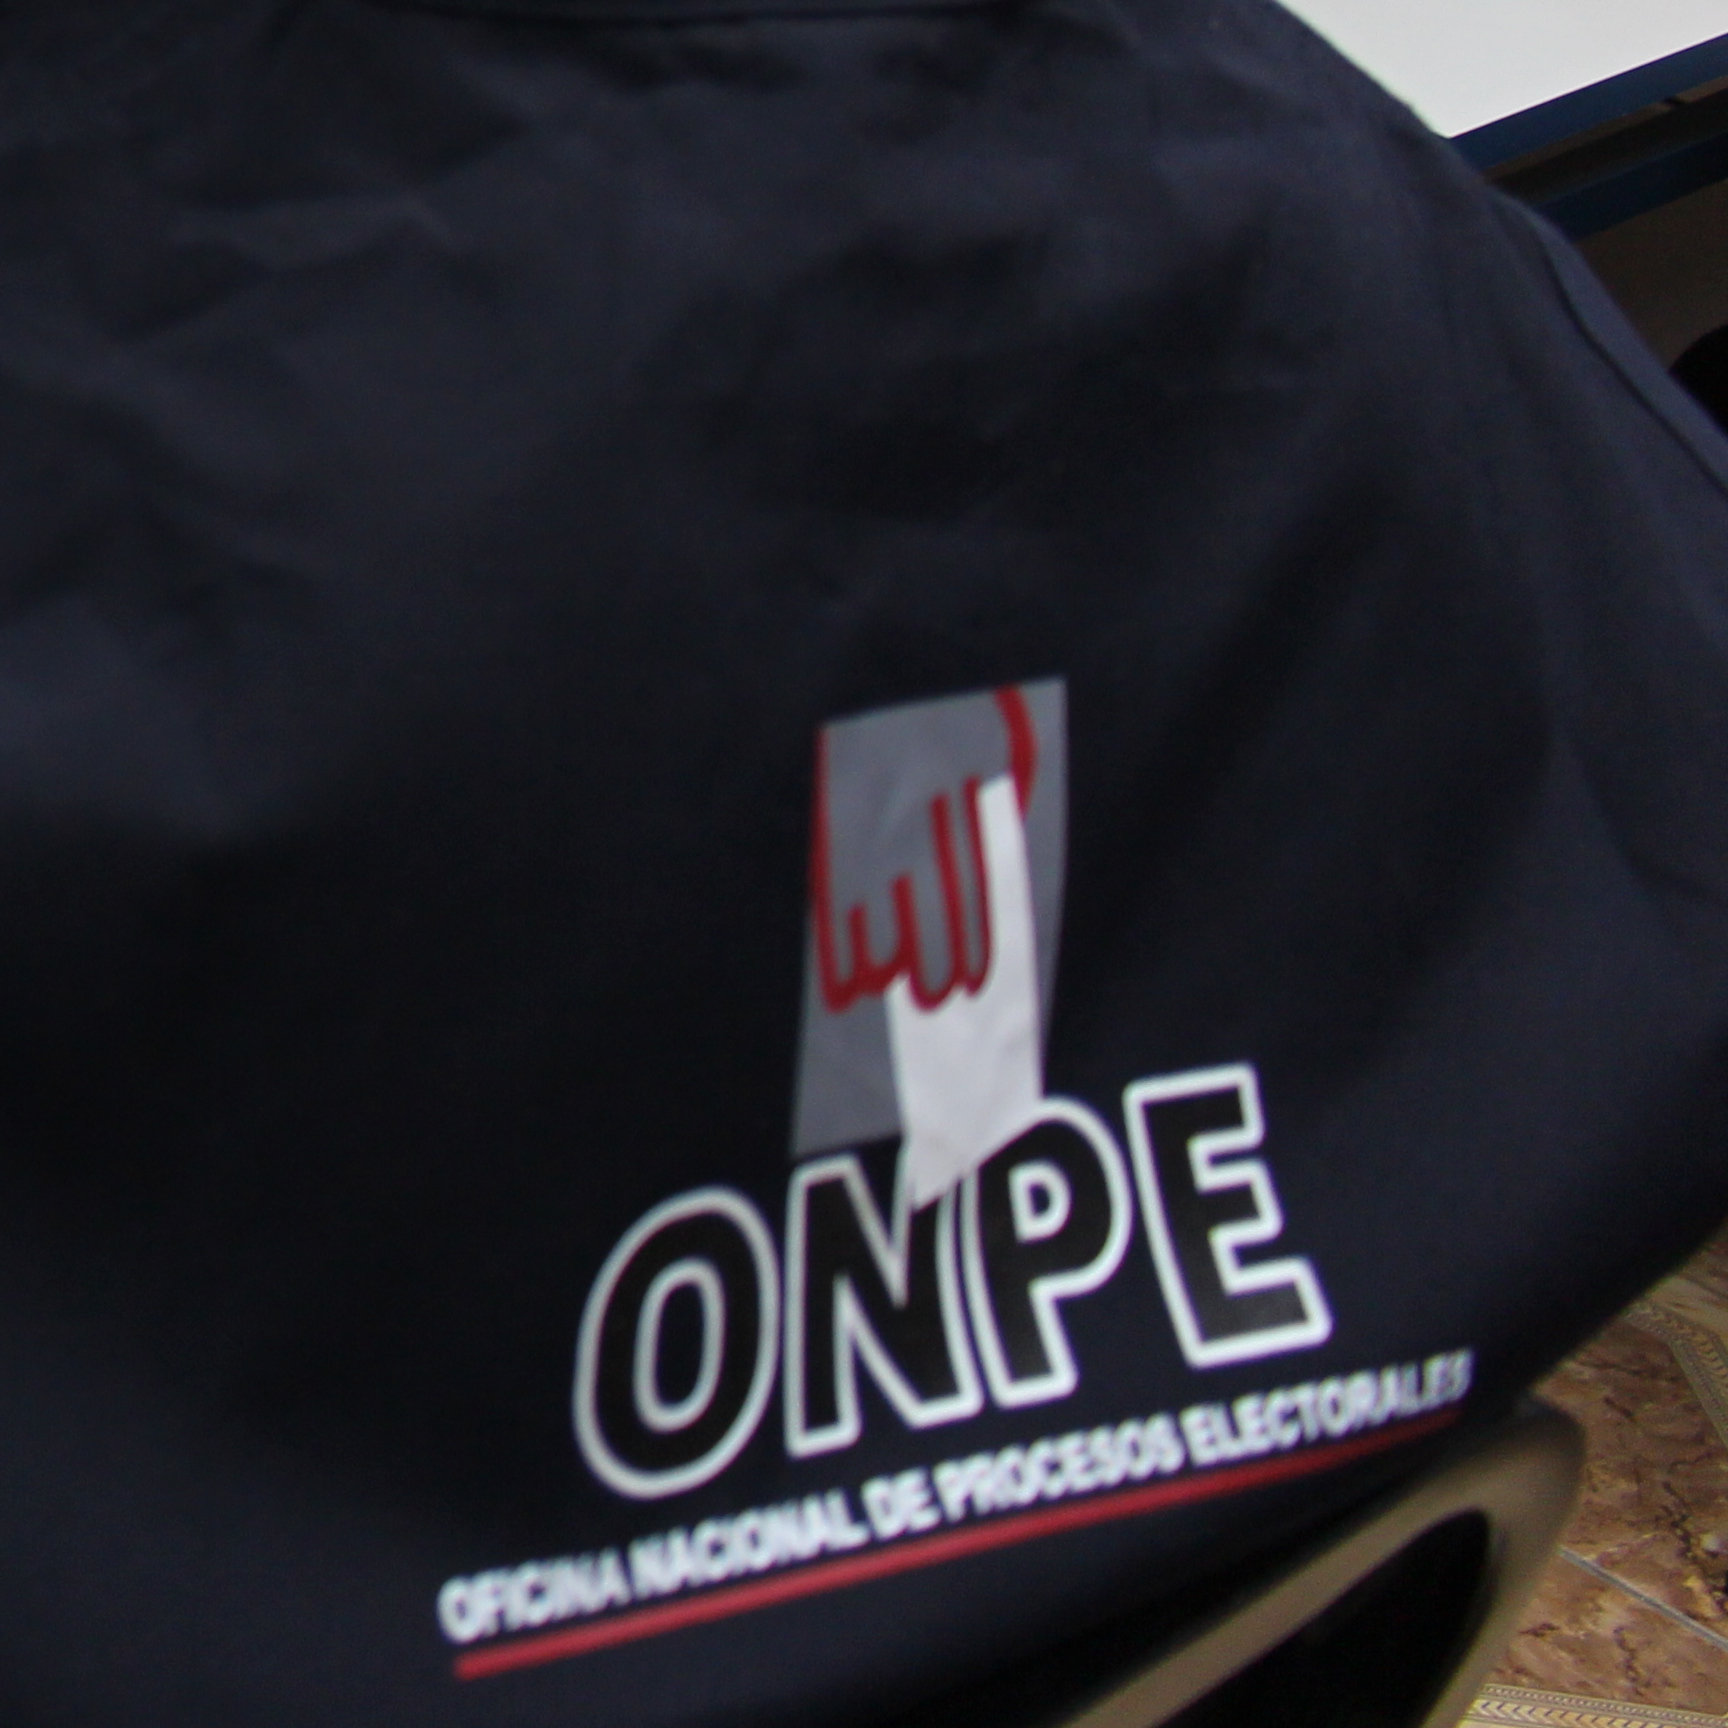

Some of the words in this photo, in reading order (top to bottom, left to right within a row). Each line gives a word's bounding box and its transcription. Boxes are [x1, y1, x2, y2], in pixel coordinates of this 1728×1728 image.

[572, 1062, 1332, 1500] ONPE
[439, 1543, 630, 1643] OFICINA
[629, 1490, 866, 1596] NACIONAL
[864, 1467, 940, 1542] DE
[942, 1412, 1185, 1519] PROCESOS
[1188, 1350, 1474, 1464] ELECTORALES
